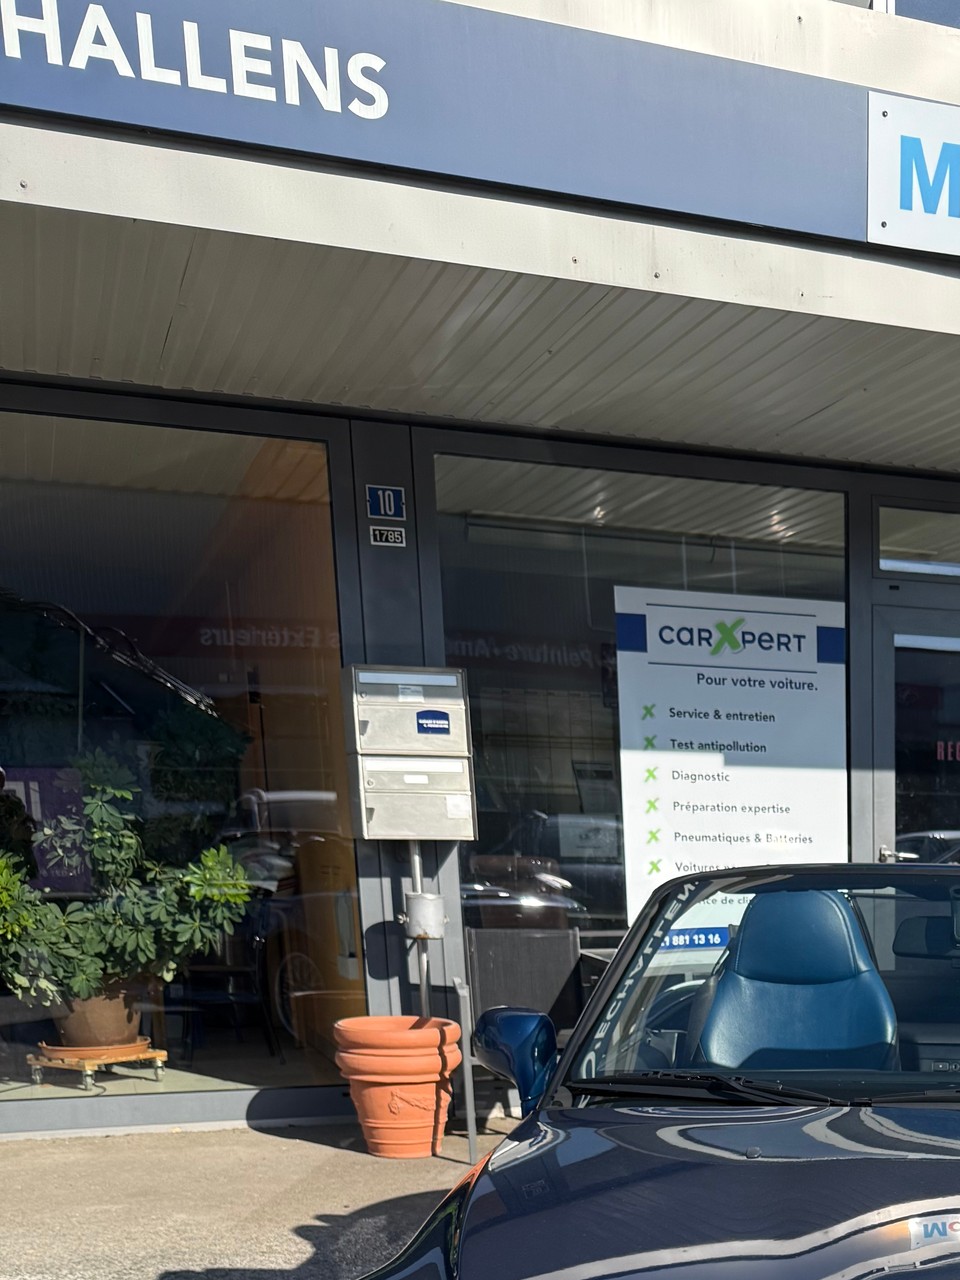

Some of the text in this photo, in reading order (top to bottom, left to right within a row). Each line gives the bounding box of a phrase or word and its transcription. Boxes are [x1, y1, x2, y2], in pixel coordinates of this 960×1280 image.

[1, 0, 390, 120] HALLENS
[377, 490, 395, 515] 10
[374, 530, 402, 543] 1785
[697, 672, 818, 691] Pour votre voiture.
[669, 707, 776, 723] Service & entretien
[670, 738, 767, 753] Test antipollution
[672, 770, 730, 784] Diagnostic
[673, 801, 791, 815] Préparation expertise
[674, 832, 813, 845] Pneumatiques & Batteries
[720, 896, 734, 905] de
[672, 934, 690, 946] 881
[692, 933, 706, 945] 13
[708, 933, 721, 945] 16
